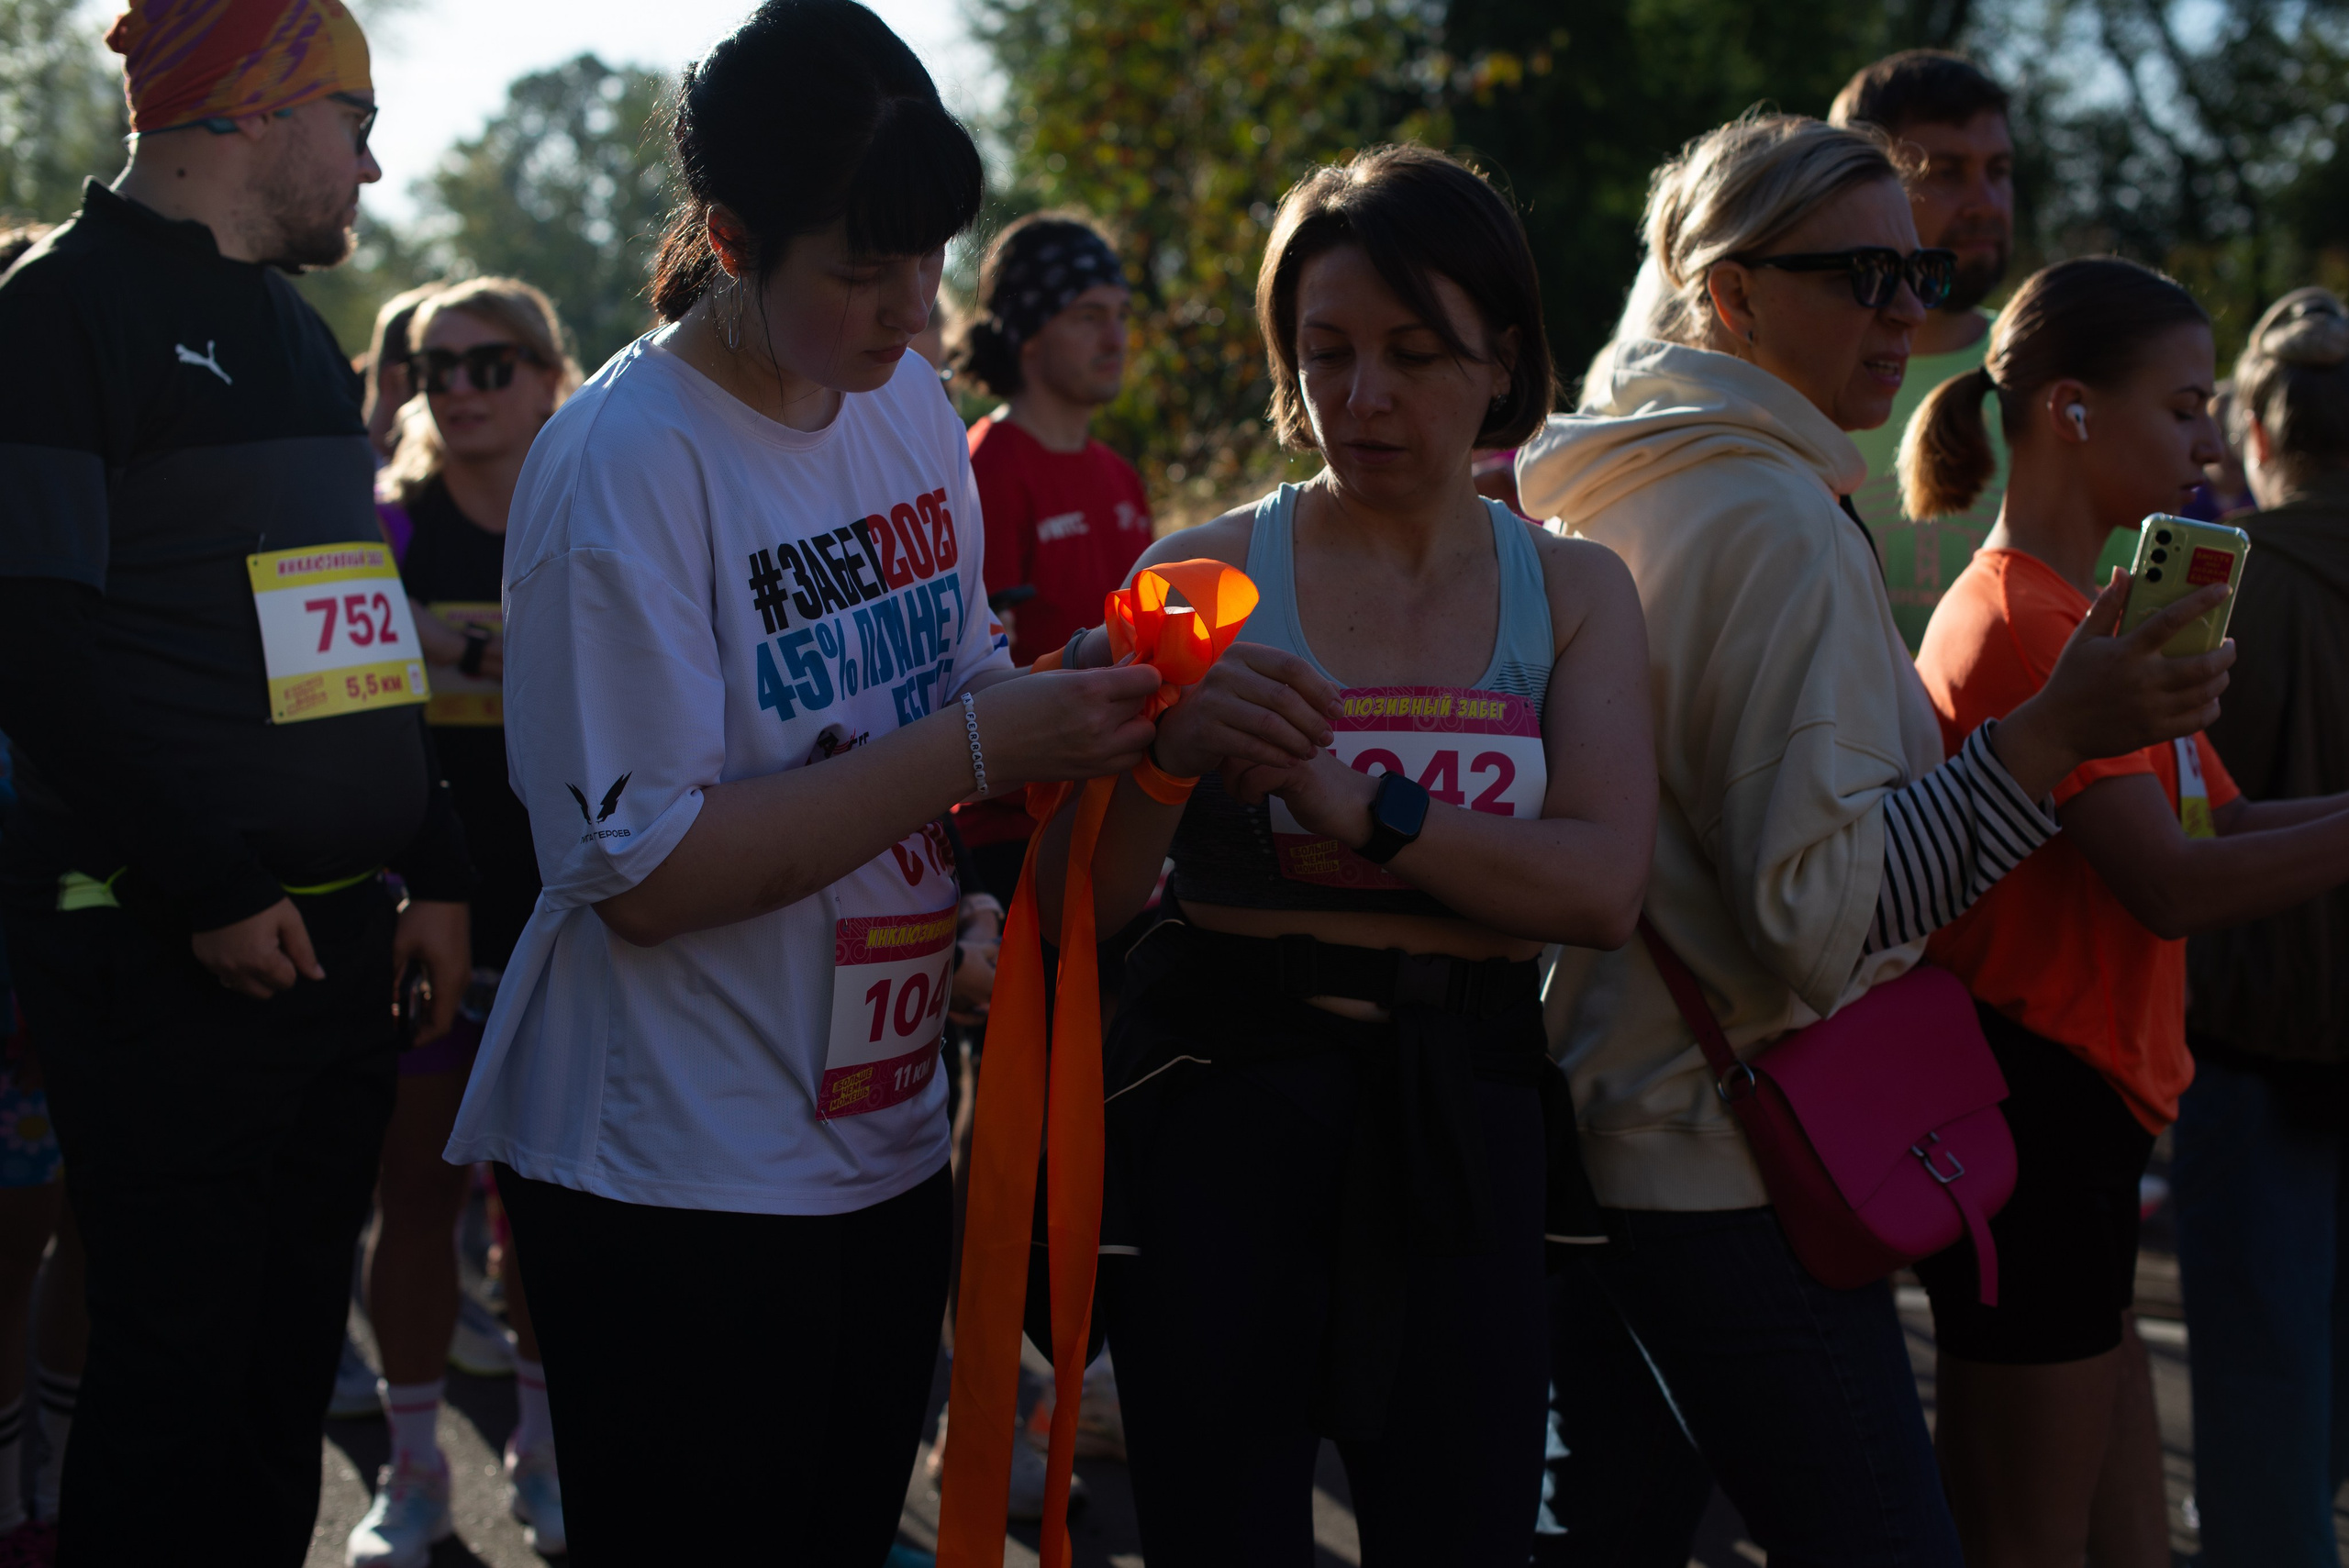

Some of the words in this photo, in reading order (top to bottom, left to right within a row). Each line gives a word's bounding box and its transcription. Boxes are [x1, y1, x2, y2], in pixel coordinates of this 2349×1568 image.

[306, 592, 398, 653] 752
[757, 618, 858, 721] 45%
[346, 673, 379, 701] 5,5
[1457, 701, 1507, 720] ЗАБЕГ
[966, 713, 985, 778] FERRARI
[1295, 840, 1337, 856] БОЛЬШЕ
[1303, 854, 1324, 864] ЧЕМ
[1295, 862, 1338, 873] МОЖЕШЬ
[837, 1067, 873, 1090] БОЛЬШЕ
[894, 1062, 912, 1092] 11
[829, 1088, 869, 1110] МОЖЕШЬ
[841, 1082, 861, 1095] ЧЕМ
